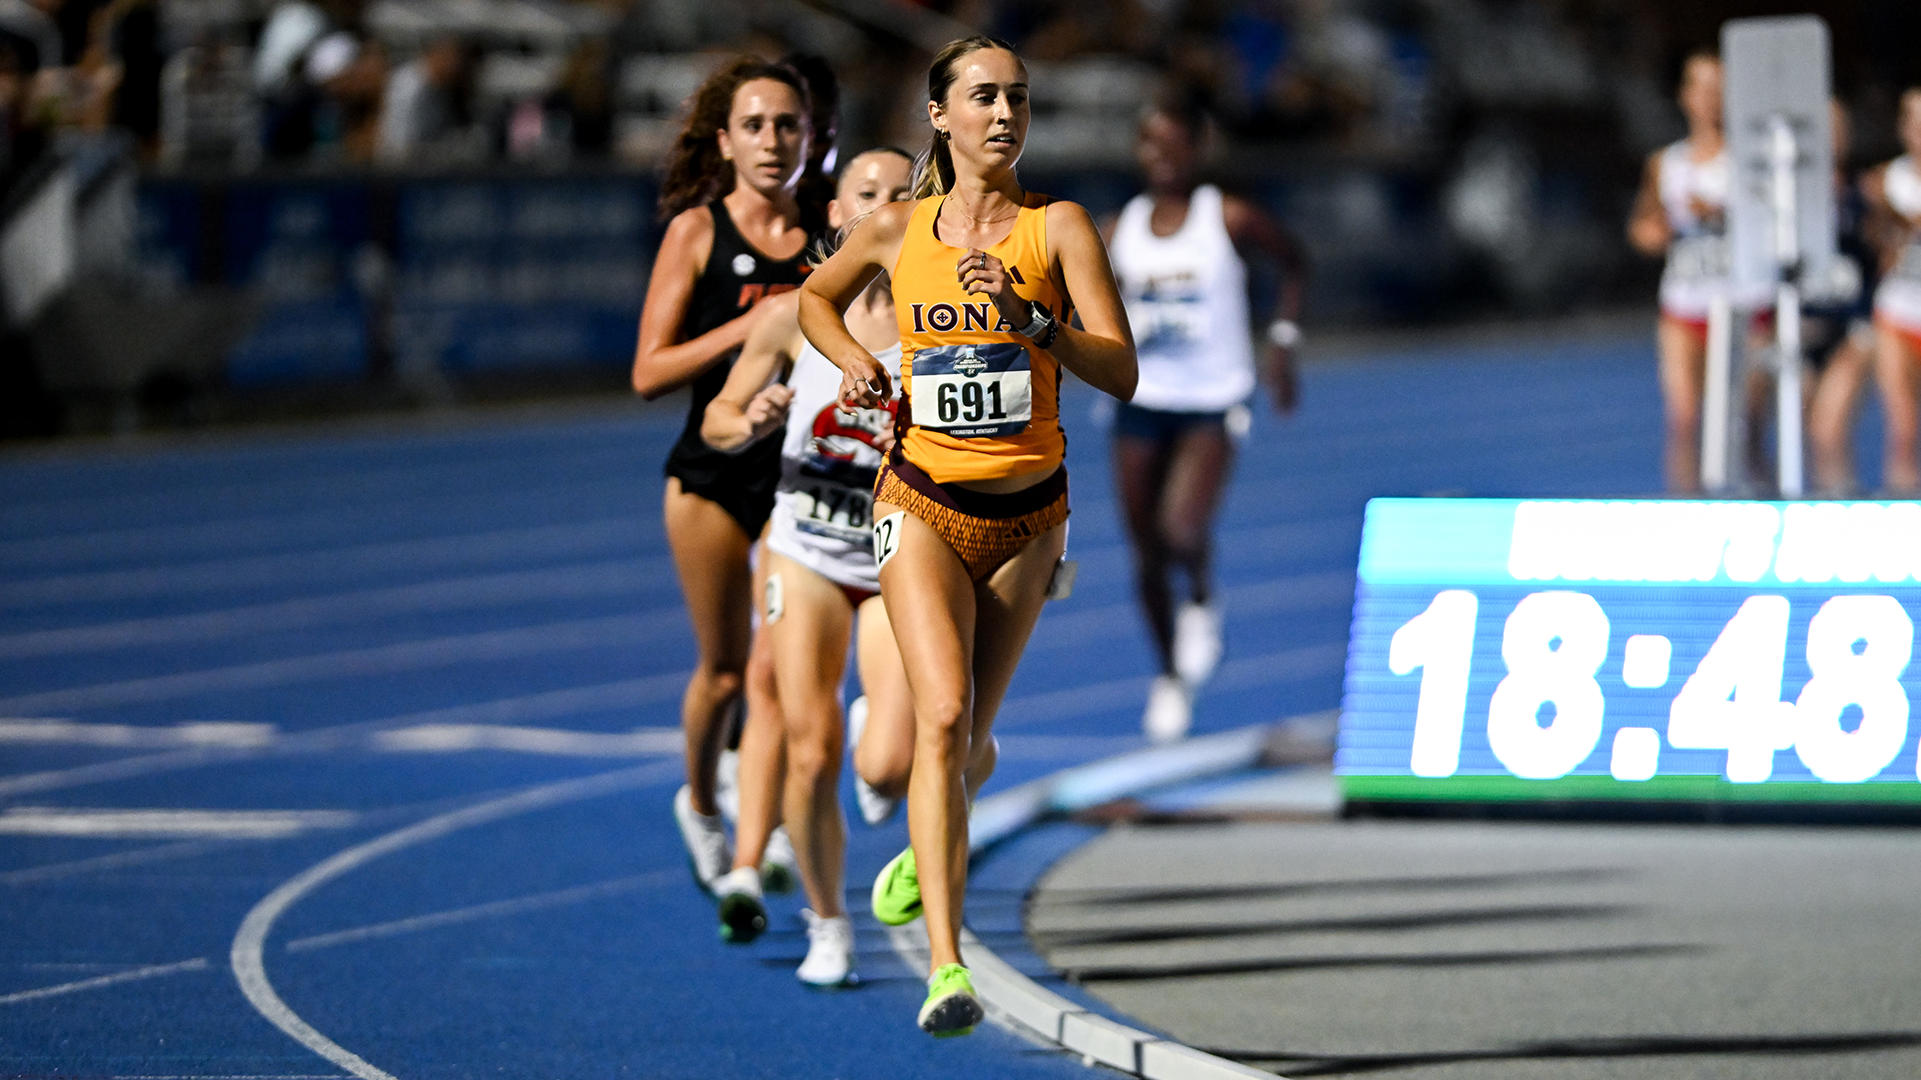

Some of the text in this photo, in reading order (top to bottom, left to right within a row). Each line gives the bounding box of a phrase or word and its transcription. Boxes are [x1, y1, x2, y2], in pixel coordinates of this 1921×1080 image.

[937, 380, 1007, 423] 691
[809, 486, 874, 529] 178
[1389, 590, 1921, 784] 18:48
